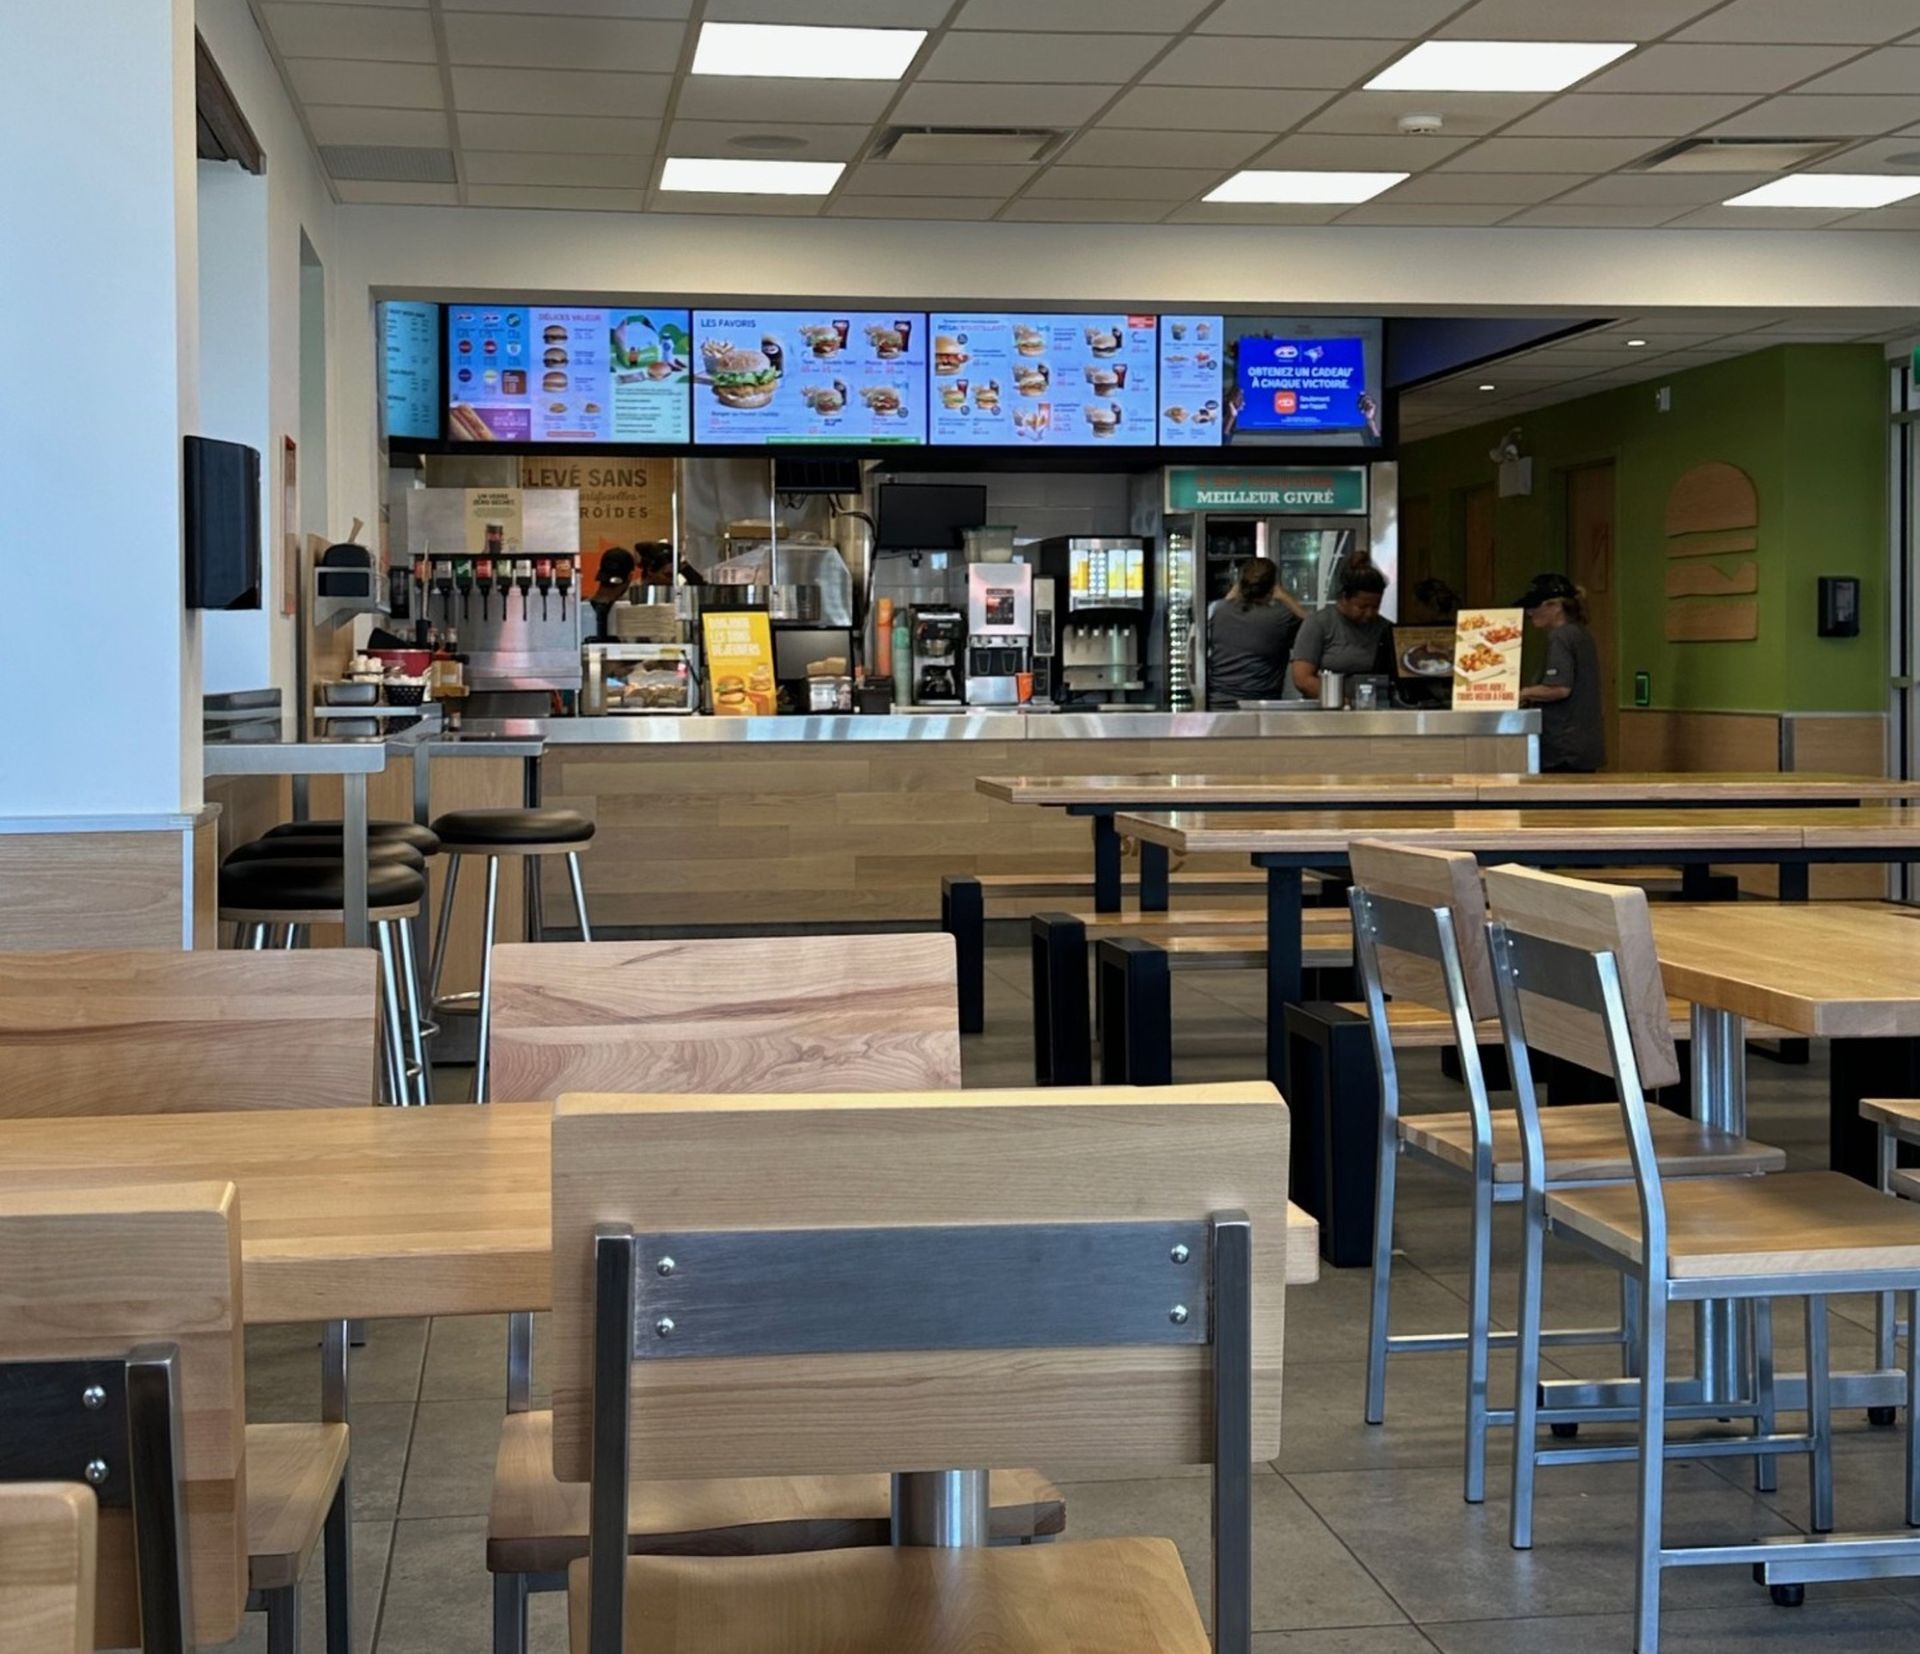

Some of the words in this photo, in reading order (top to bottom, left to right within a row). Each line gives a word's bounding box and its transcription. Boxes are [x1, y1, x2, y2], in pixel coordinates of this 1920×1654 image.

[701, 318, 717, 328] LES
[718, 318, 756, 328] FAVORIS
[1247, 366, 1295, 377] OBTENEZ
[1296, 366, 1310, 377] UN
[1252, 376, 1260, 388] À
[1260, 378, 1301, 389] CHAQUE
[588, 468, 648, 487] SANS
[1196, 491, 1280, 504] MEILLEUR
[1283, 488, 1334, 504] GIVRÉ
[579, 504, 649, 519] ROÏDES
